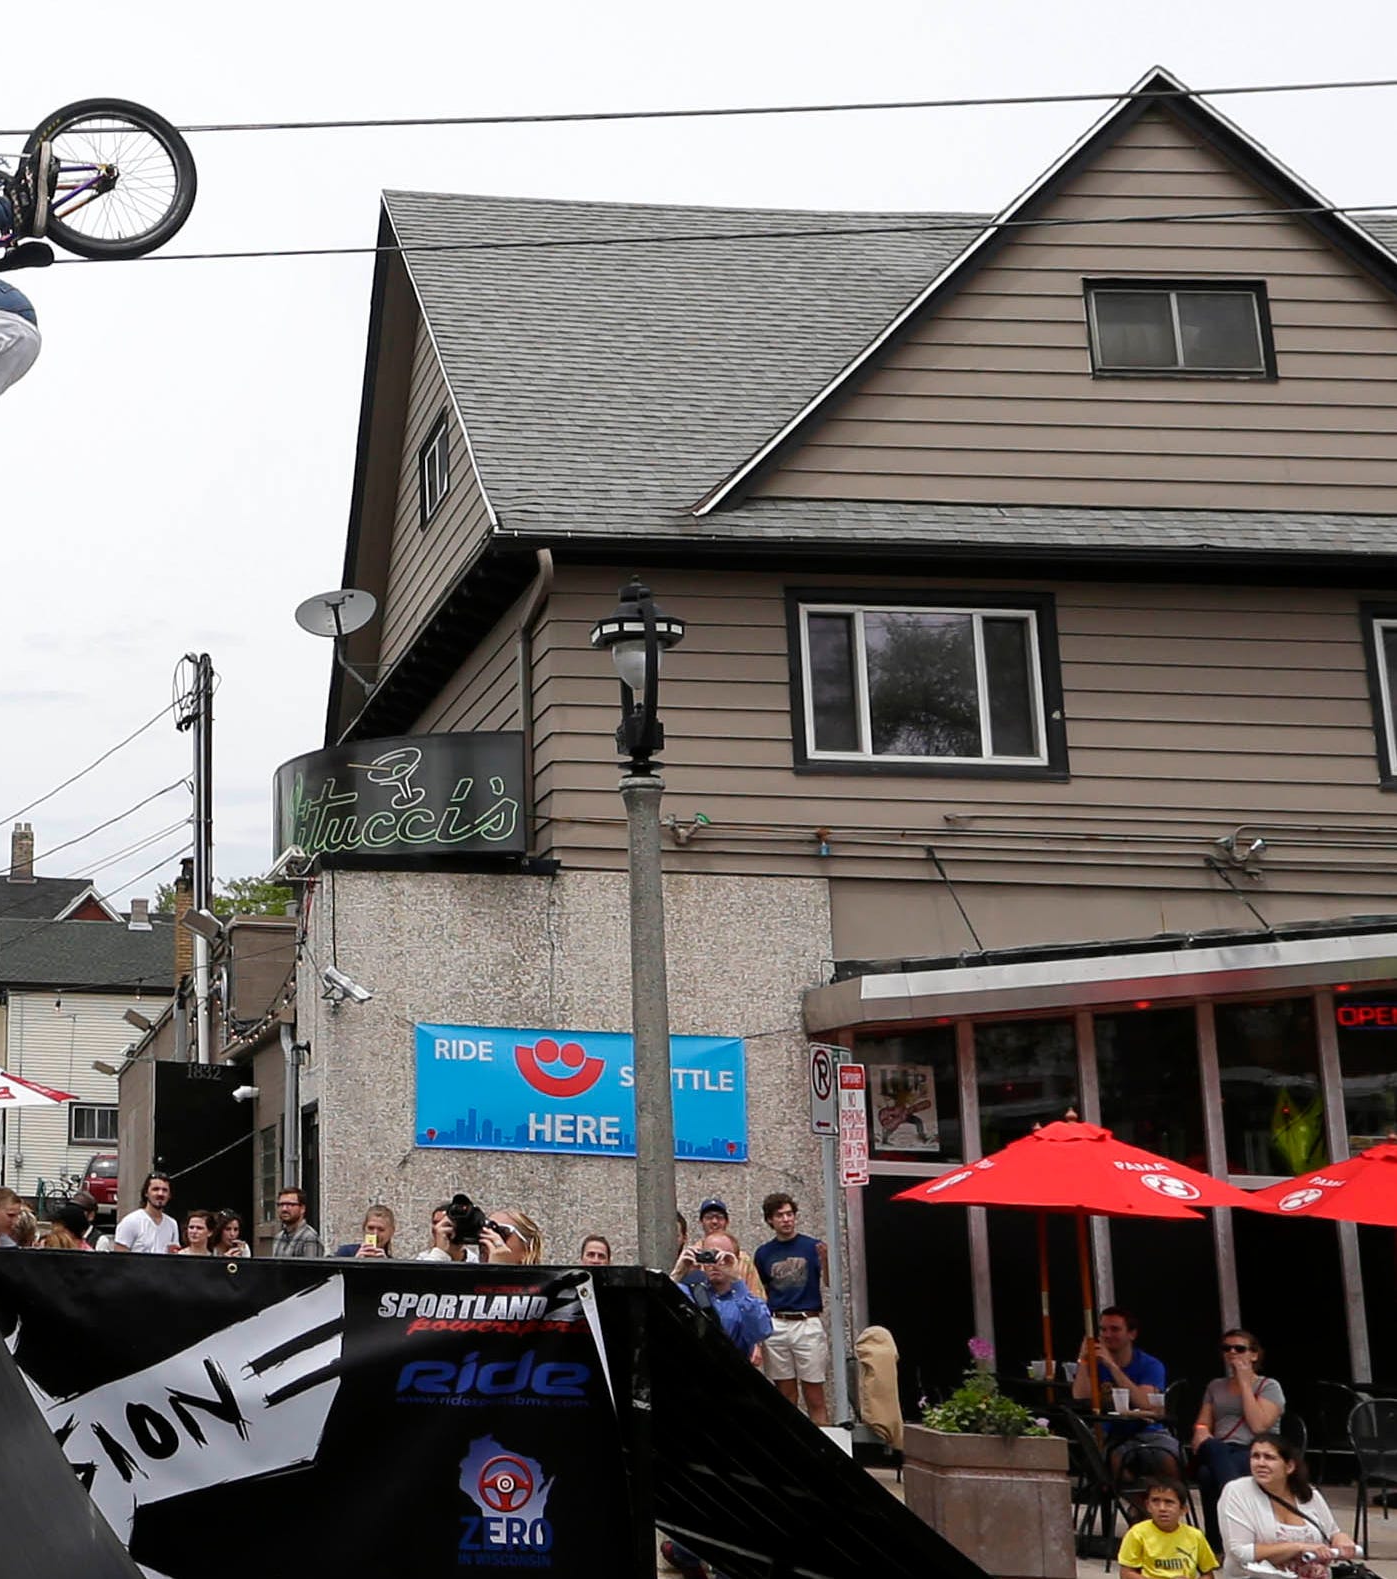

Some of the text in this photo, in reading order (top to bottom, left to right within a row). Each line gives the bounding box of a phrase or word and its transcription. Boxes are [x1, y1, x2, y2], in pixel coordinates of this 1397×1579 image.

[1336, 1006, 1397, 1026] OPE
[434, 1038, 494, 1062] RIDE
[186, 1063, 222, 1080] 1832
[619, 1065, 735, 1092] STTLE
[528, 1112, 620, 1145] HERE
[377, 1292, 548, 1320] SPORTLAND
[406, 1318, 590, 1336] powersport
[458, 1516, 554, 1552] ZERO
